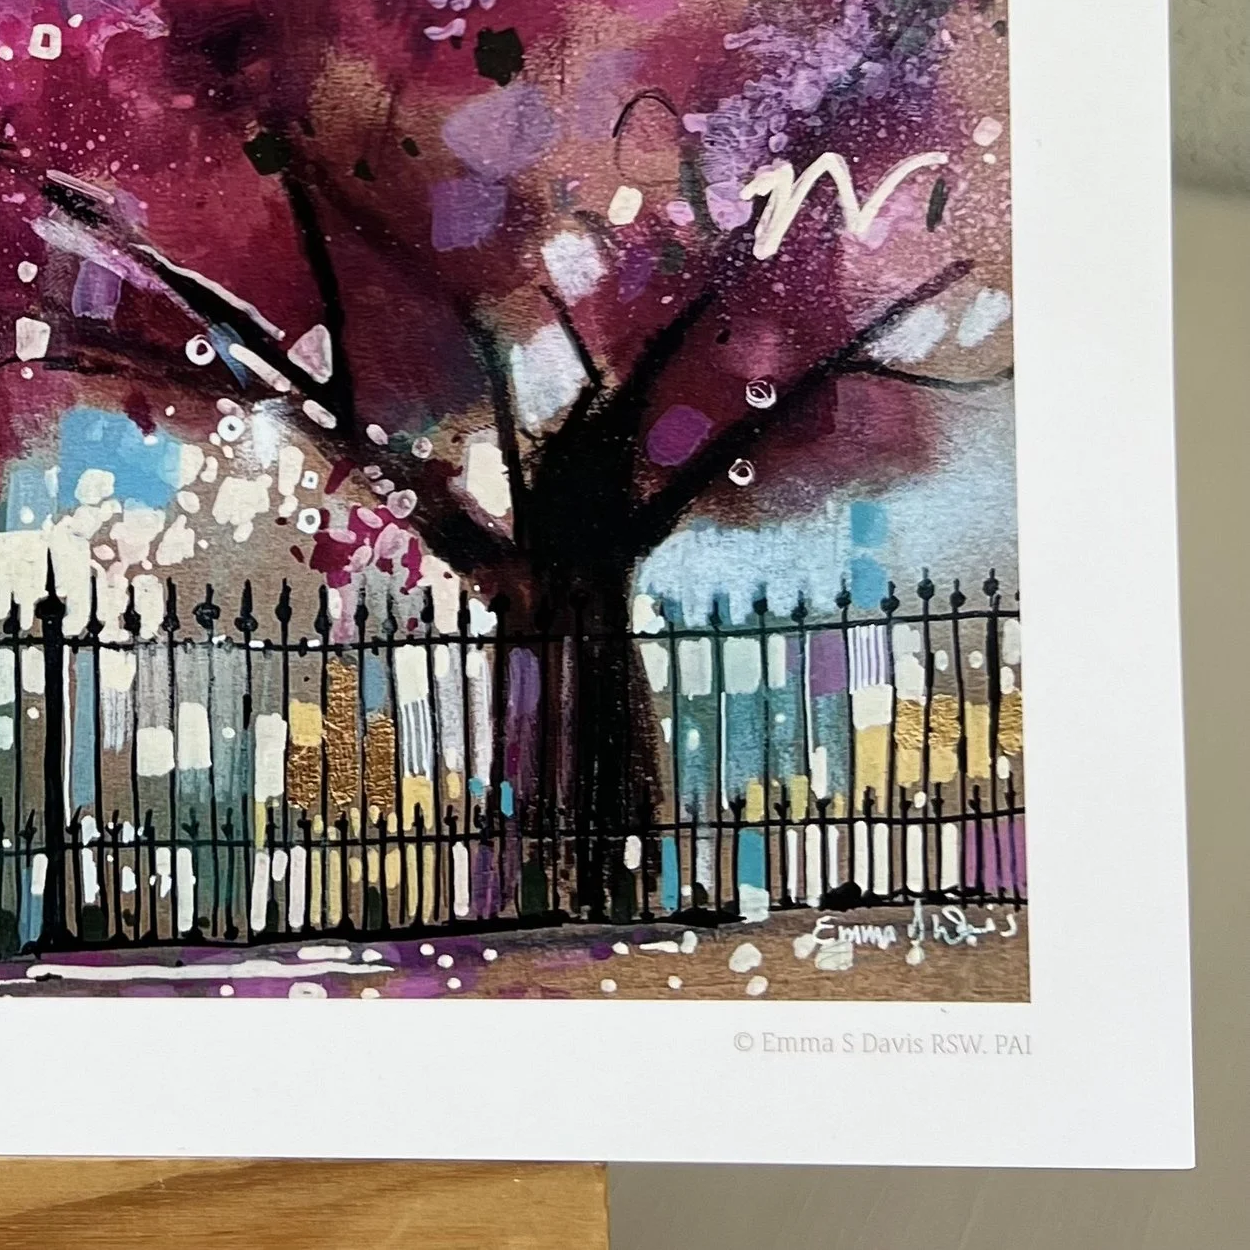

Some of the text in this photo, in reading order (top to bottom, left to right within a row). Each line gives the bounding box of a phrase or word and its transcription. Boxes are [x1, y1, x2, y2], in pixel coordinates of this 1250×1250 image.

[761, 1031, 834, 1054] Emma
[841, 1032, 855, 1054] S
[862, 1032, 924, 1055] Davis
[931, 1033, 988, 1056] RSW.
[994, 1033, 1033, 1056] PAI
